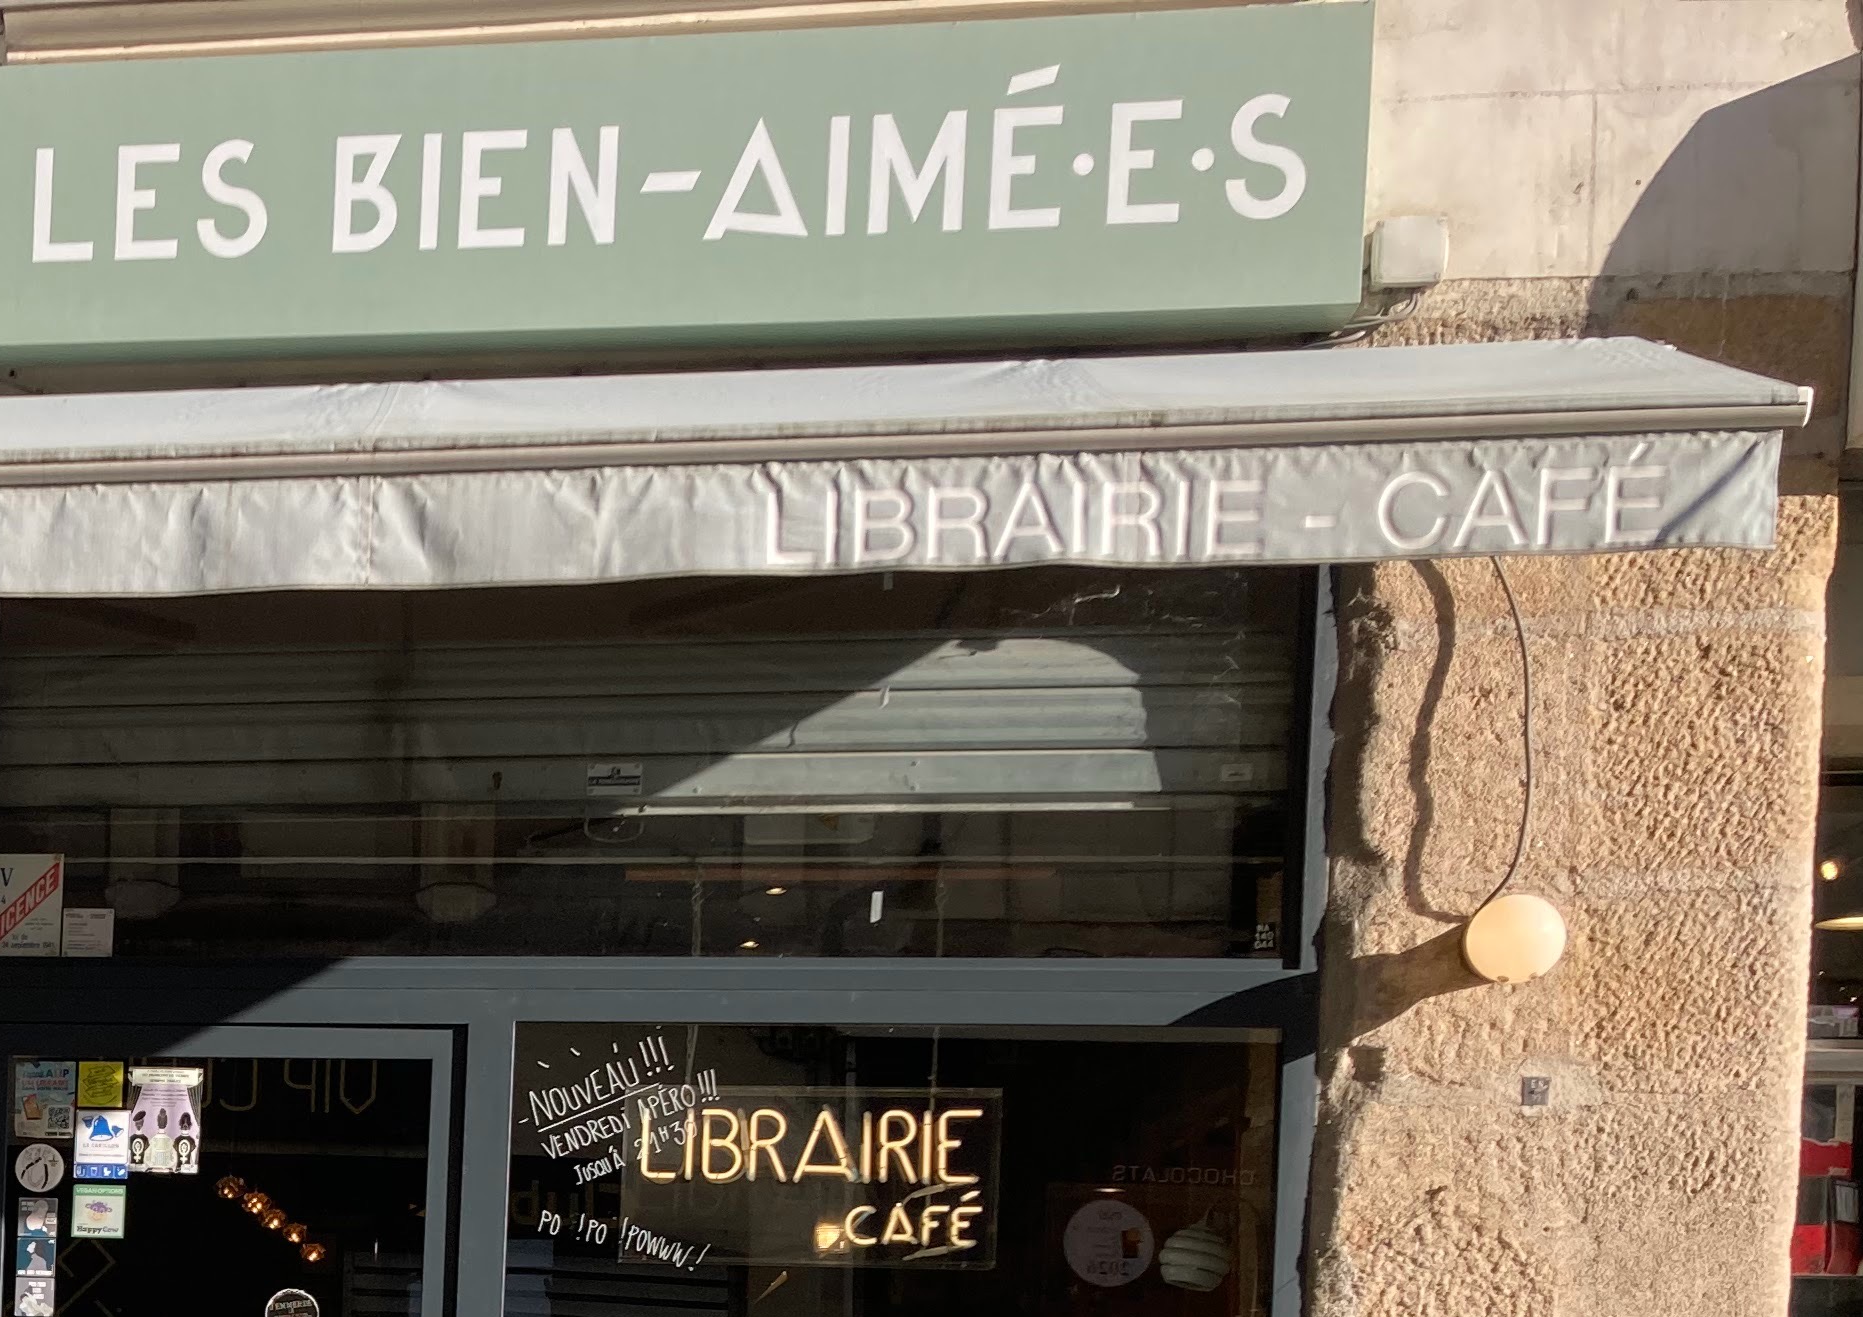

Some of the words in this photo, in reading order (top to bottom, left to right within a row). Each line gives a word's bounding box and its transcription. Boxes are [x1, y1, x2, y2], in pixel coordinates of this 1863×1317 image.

[30, 138, 270, 262] LES
[765, 477, 1265, 568] LIBRAIRIE
[1376, 440, 1668, 552] CAFÉ
[528, 1057, 640, 1127] NOUVEAU
[540, 1107, 631, 1160] VENDREDI
[636, 1084, 697, 1126] APÉRO
[573, 1145, 626, 1186] JUSQU'À
[639, 1104, 984, 1185] LIBRAIRIE
[844, 1190, 984, 1262] CAFÉ
